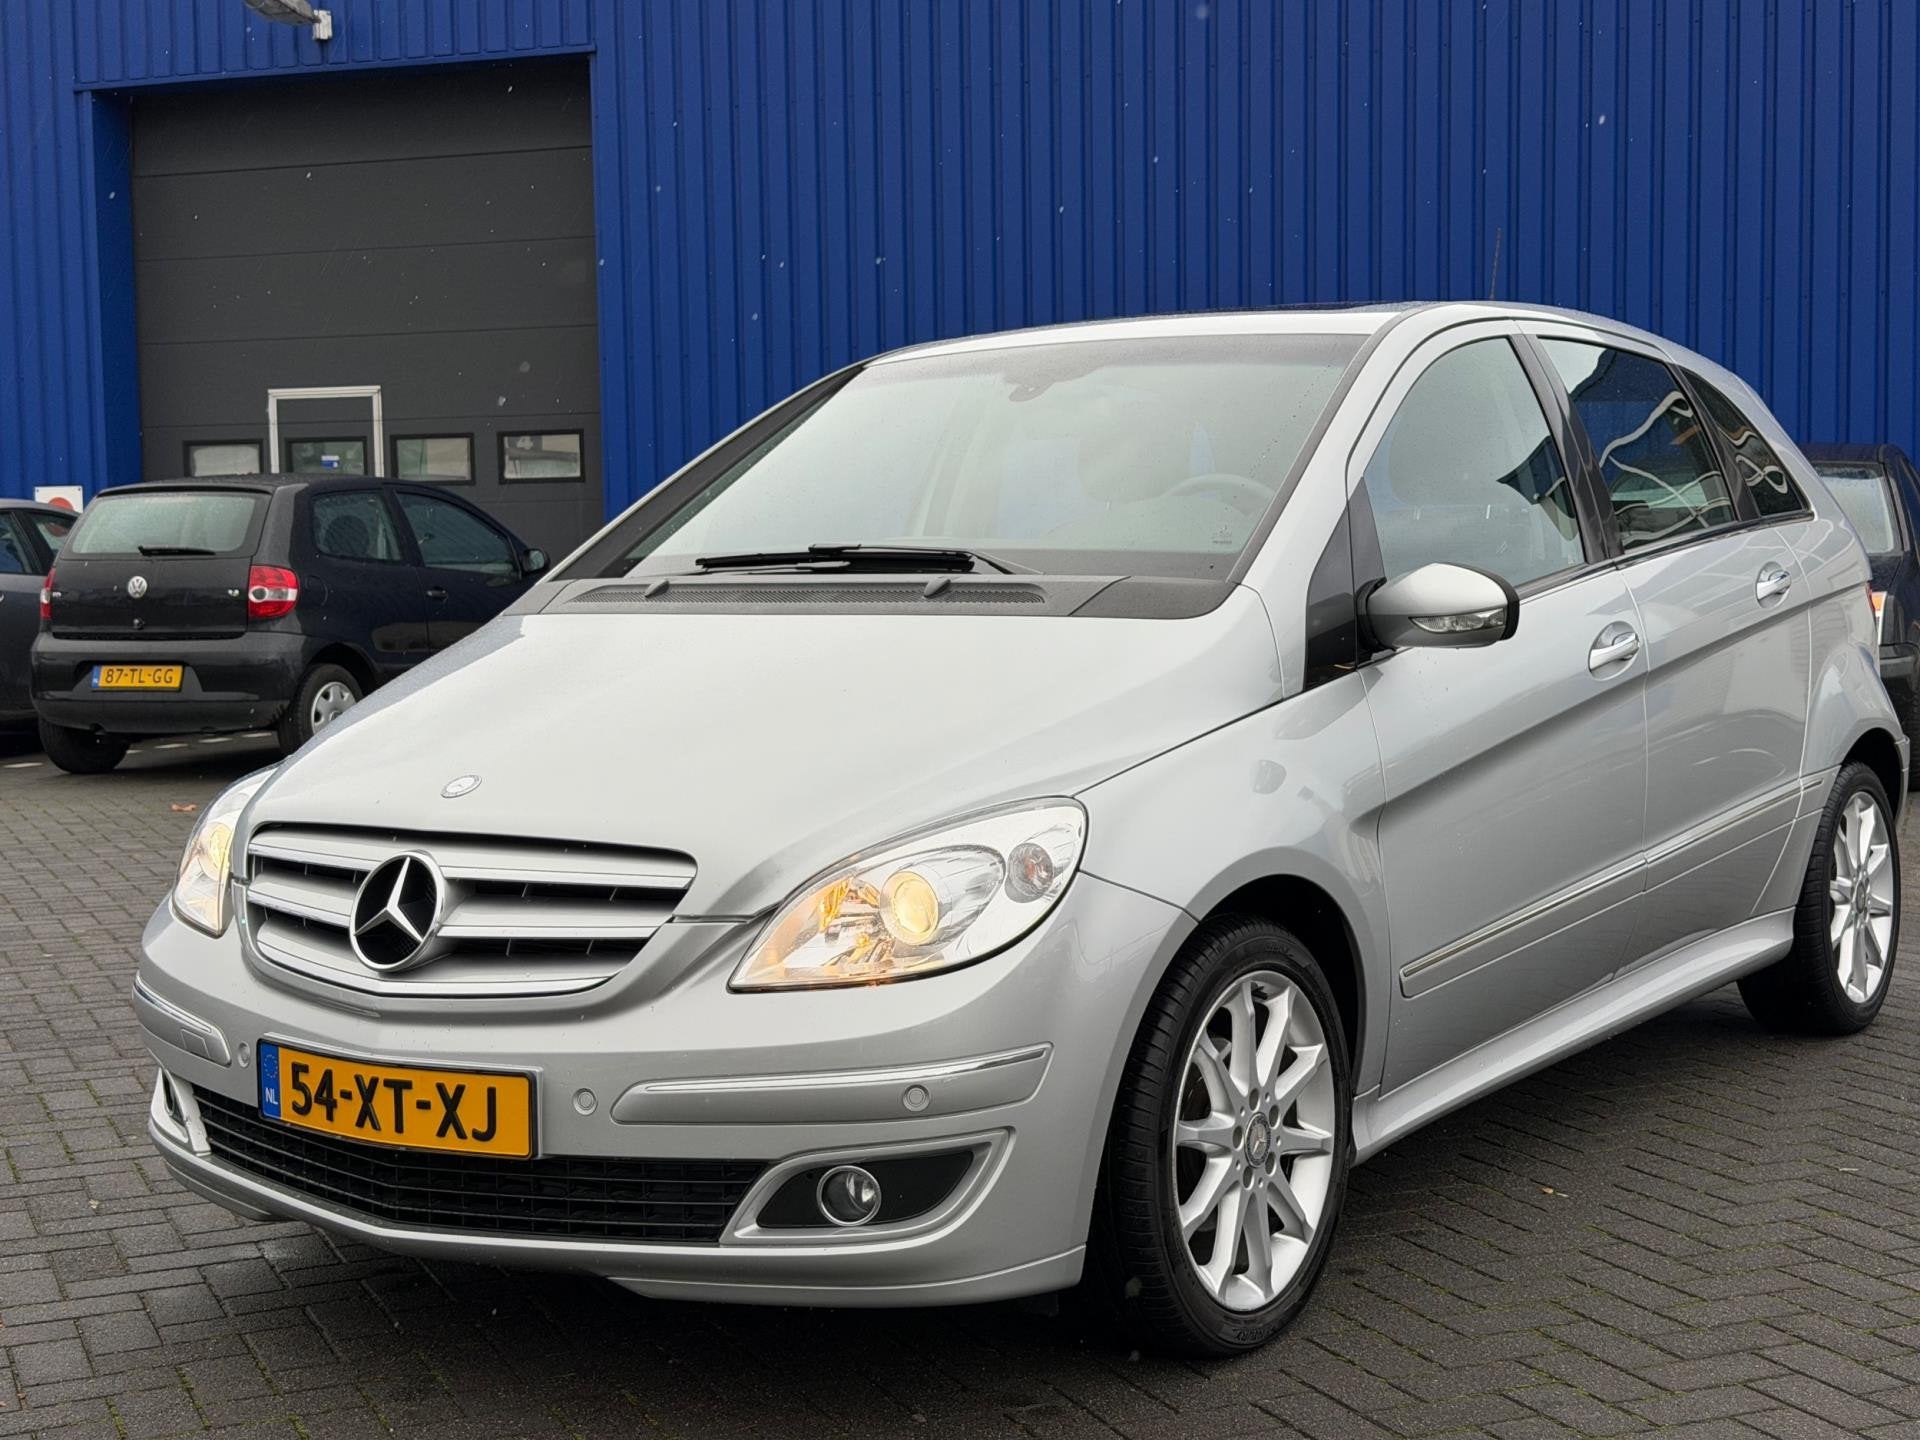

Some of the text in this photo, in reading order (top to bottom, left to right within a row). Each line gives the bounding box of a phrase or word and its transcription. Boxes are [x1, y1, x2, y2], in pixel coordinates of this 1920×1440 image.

[105, 668, 174, 684] 87-TL-GG
[265, 1087, 278, 1105] NL
[291, 1062, 497, 1142] 54-XT-XJ
